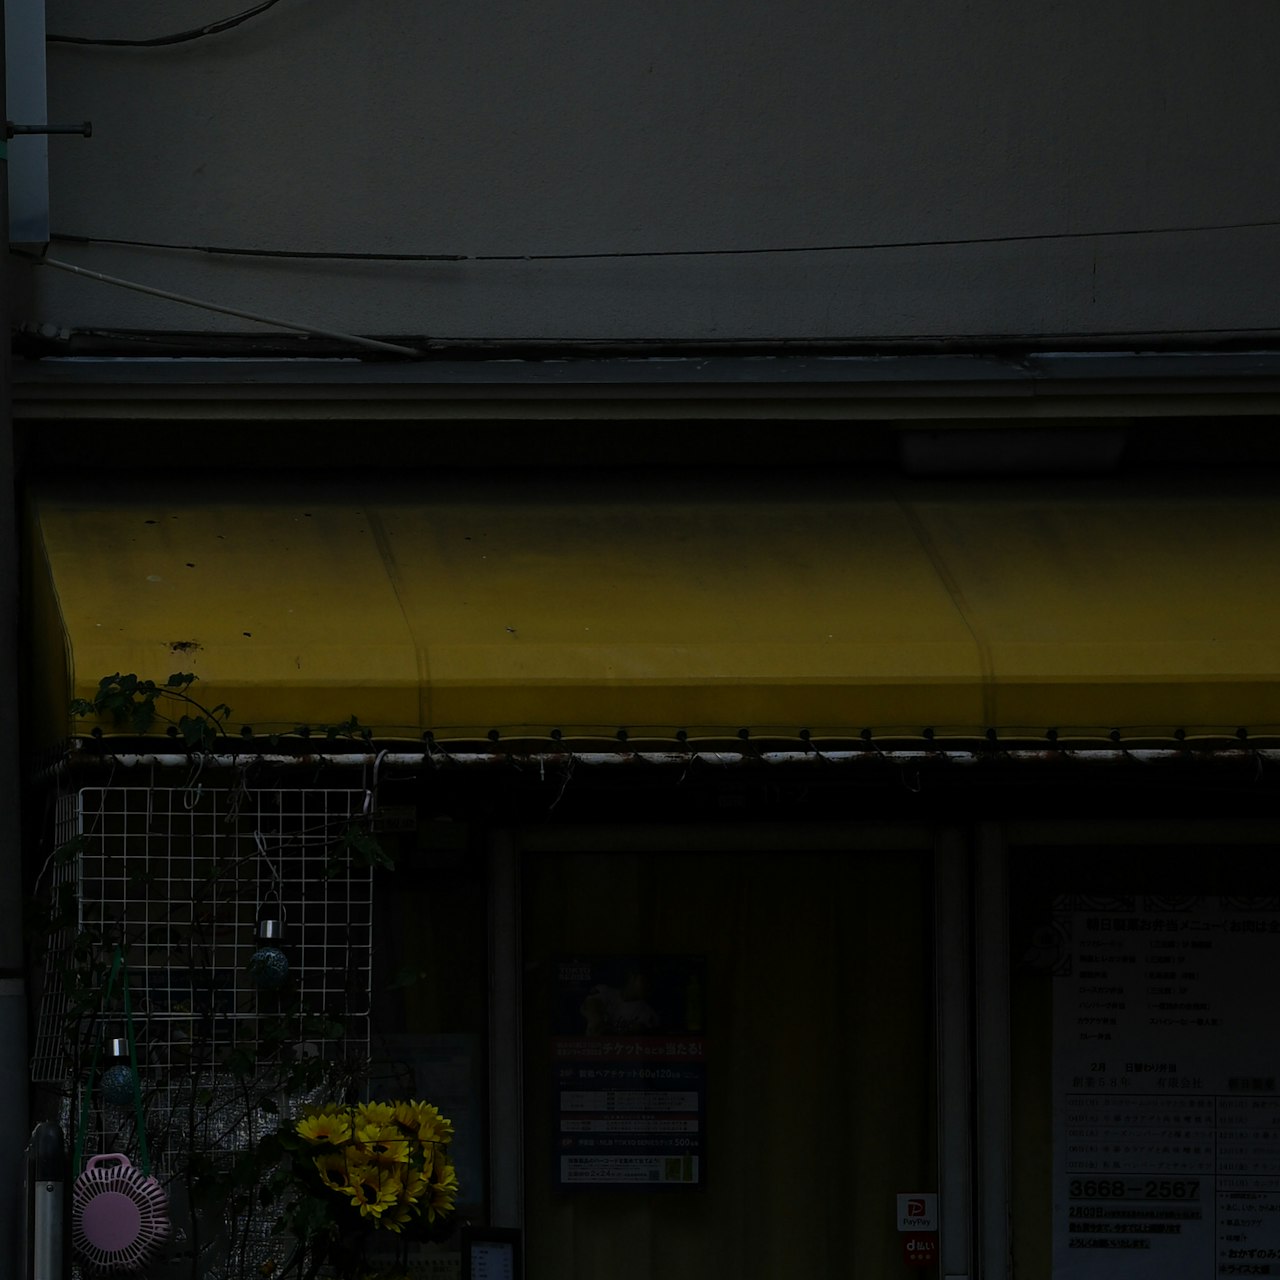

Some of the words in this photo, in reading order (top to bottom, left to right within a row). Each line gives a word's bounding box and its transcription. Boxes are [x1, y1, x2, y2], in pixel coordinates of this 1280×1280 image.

[1069, 1180, 1201, 1199] 3668-2567
[903, 1218, 931, 1228] PayPay
[906, 1239, 935, 1251] d払い
